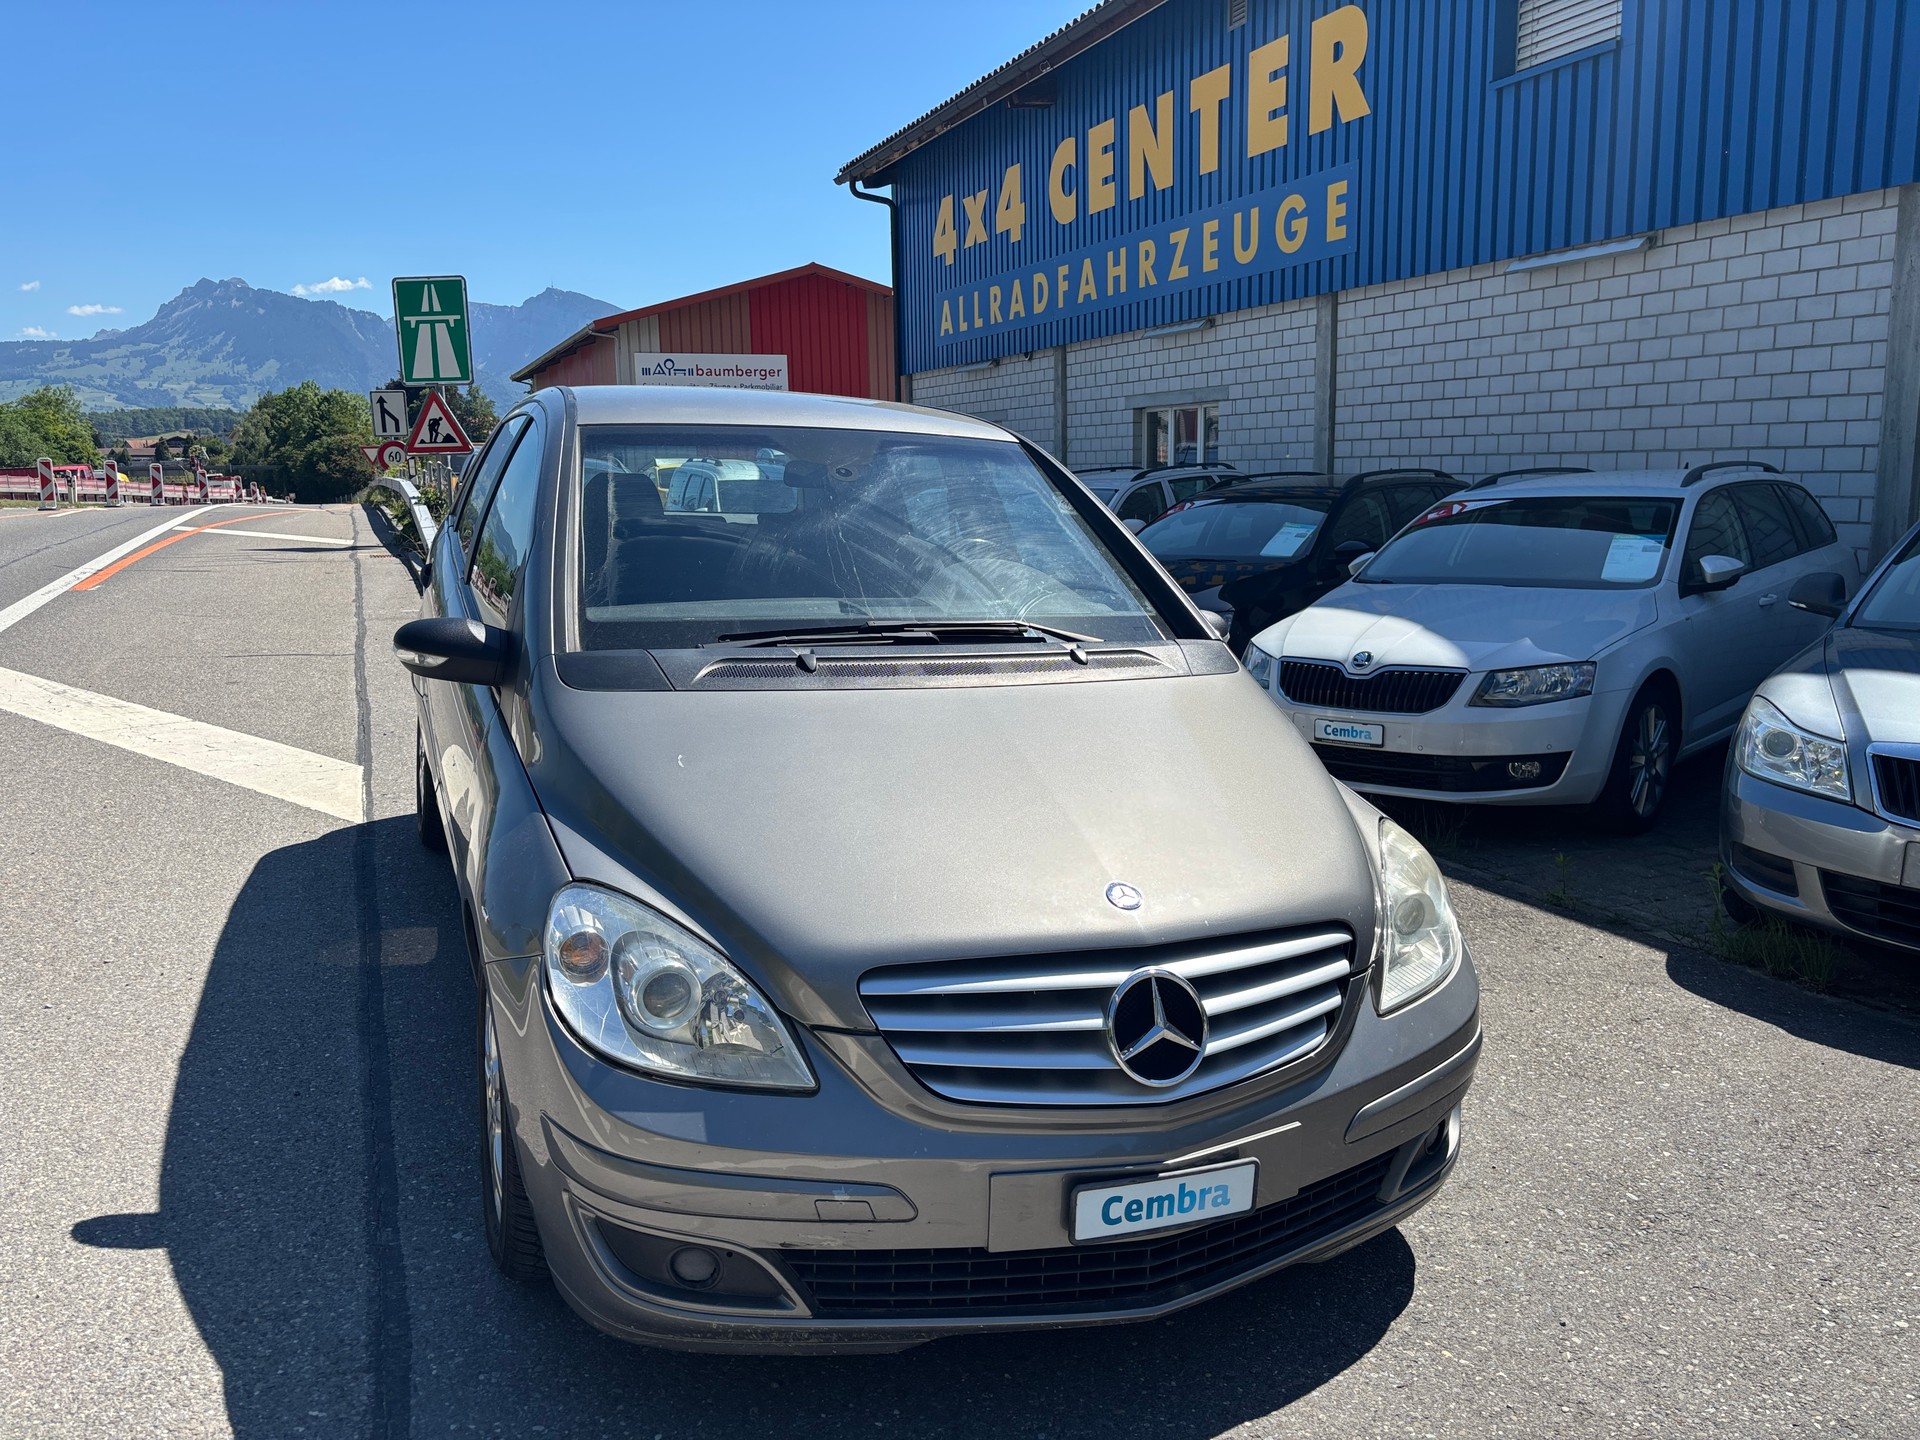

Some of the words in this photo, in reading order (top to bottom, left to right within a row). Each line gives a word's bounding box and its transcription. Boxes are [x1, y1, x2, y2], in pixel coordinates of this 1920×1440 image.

[933, 163, 1026, 267] 4x4
[1048, 4, 1372, 226] CENTER
[940, 180, 1348, 337] ALLRADFAHRZEUGE
[696, 364, 782, 380] baumberger
[388, 451, 402, 463] 60
[1323, 724, 1373, 740] Cembra
[1101, 1182, 1231, 1226] Cembra
